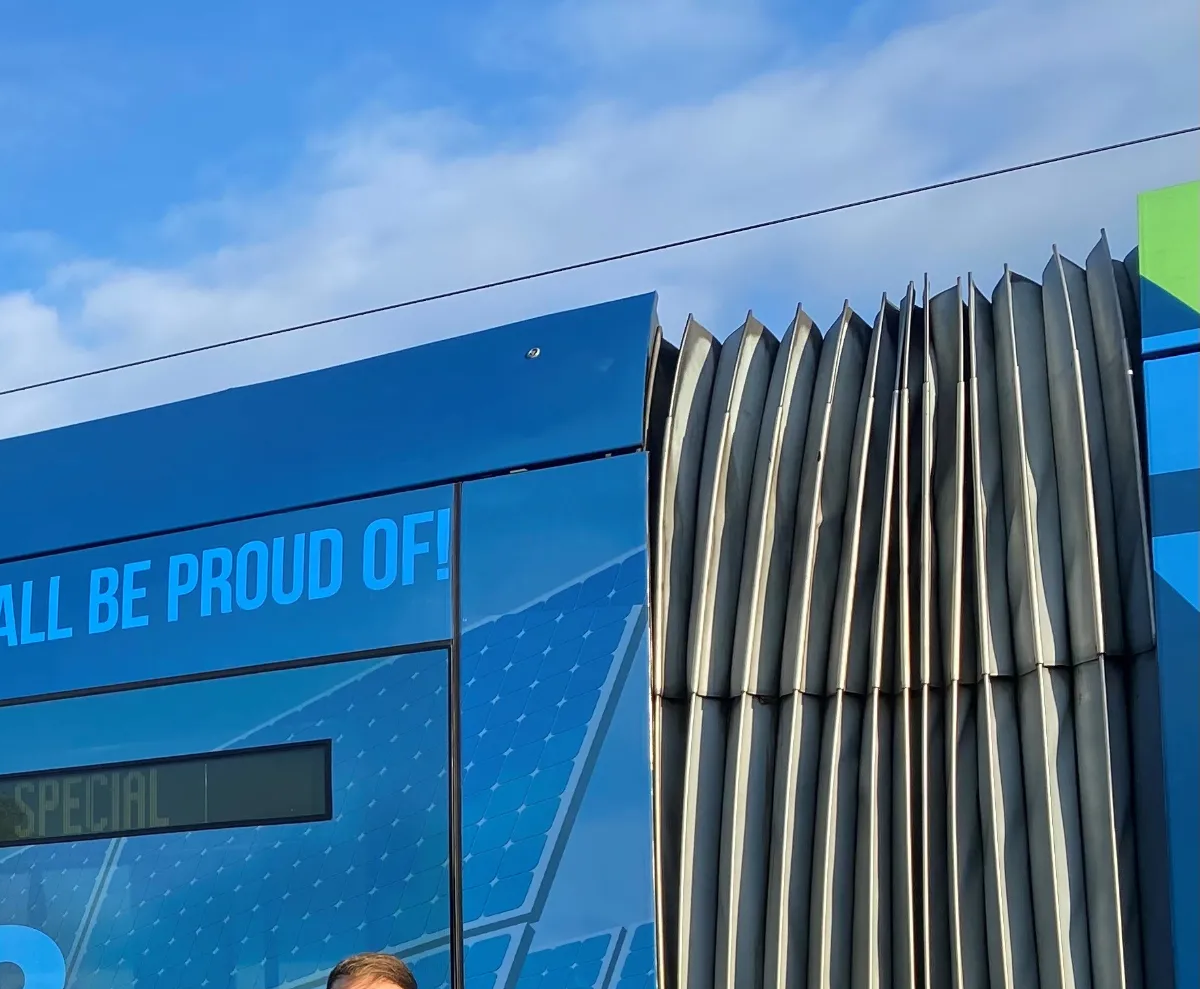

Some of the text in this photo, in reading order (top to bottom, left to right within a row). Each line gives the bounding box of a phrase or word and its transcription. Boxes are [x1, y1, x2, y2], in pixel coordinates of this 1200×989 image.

[88, 559, 151, 634] BE
[167, 527, 343, 623] PROUD
[362, 508, 451, 591] OF!
[14, 768, 170, 838] SPECIAL
